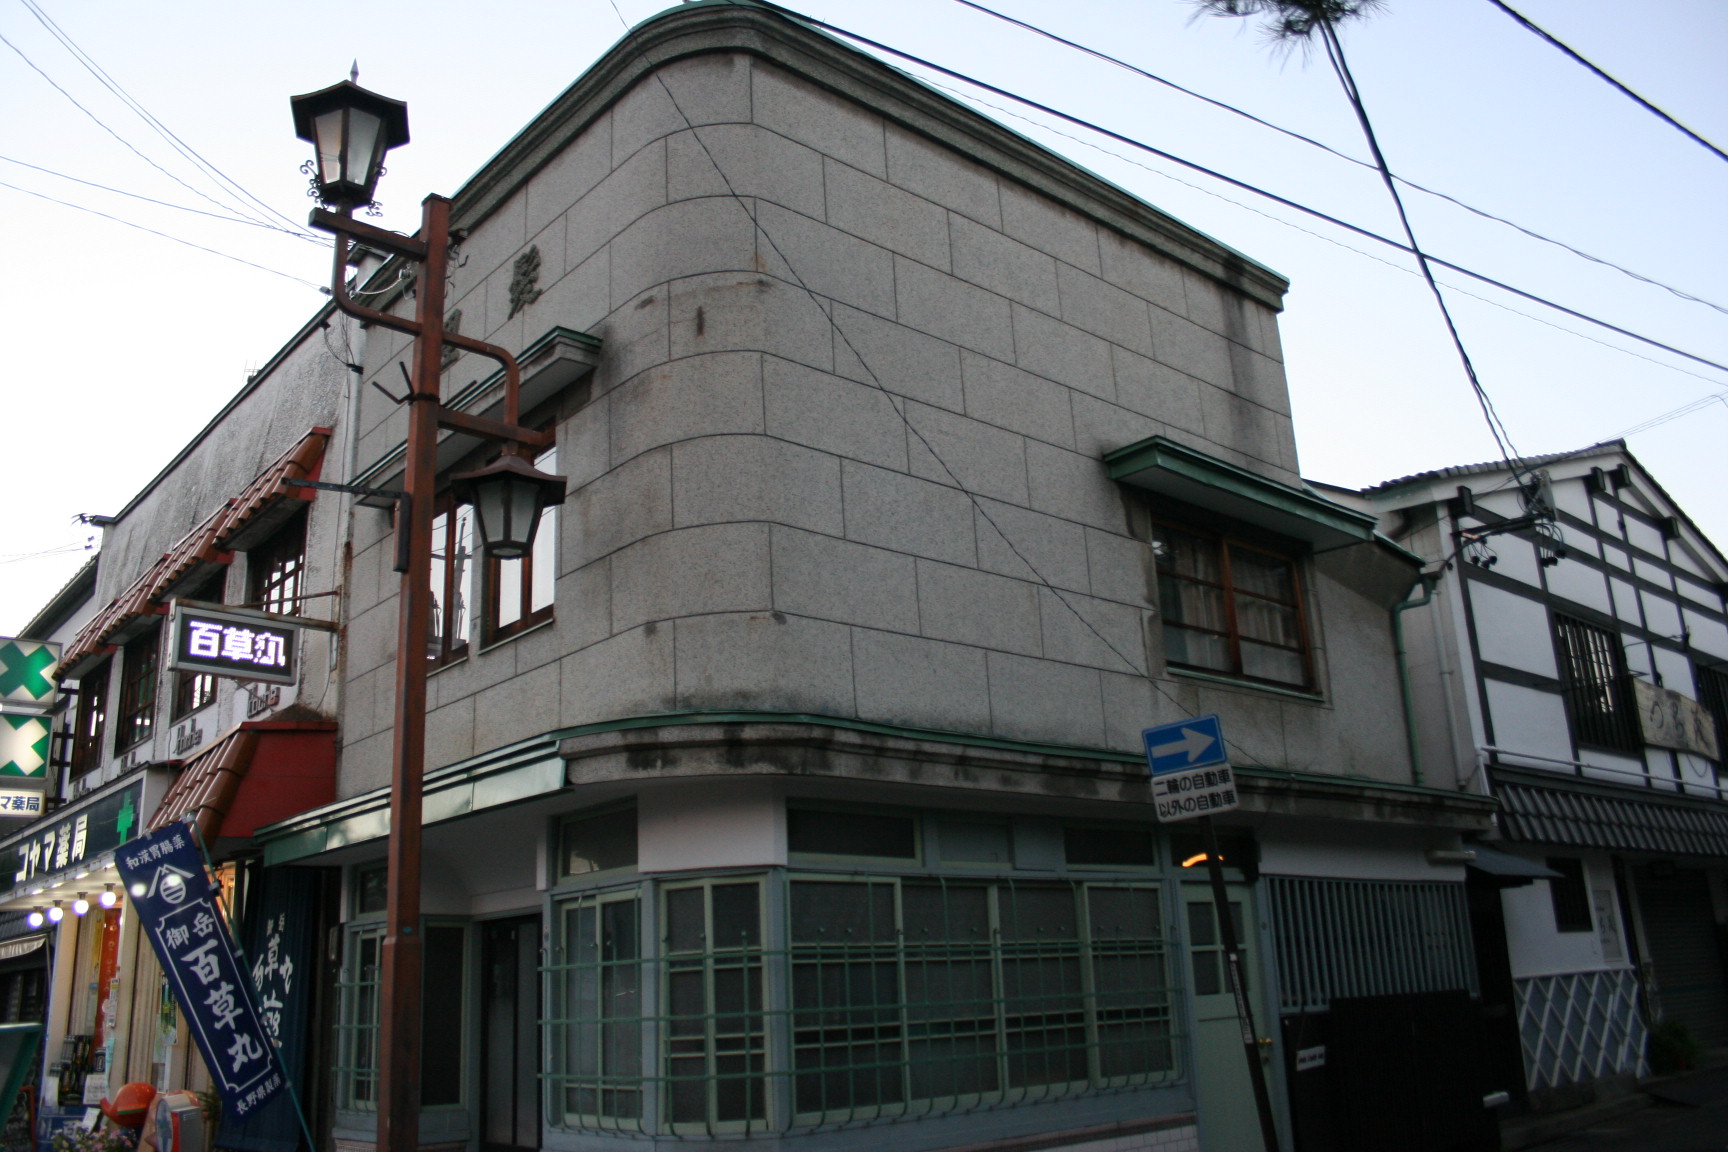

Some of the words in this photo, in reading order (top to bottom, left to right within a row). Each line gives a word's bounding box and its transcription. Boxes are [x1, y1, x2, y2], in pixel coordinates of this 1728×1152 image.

[1153, 769, 1231, 797] 二輪の自動車
[0, 795, 40, 812] マ薬局
[1158, 790, 1237, 818] 以外の自動車
[15, 814, 88, 883] コヤマ薬局
[125, 834, 186, 870] 和漢胃腸薬
[166, 912, 215, 950] 御岳
[181, 939, 263, 1074] 百草丸
